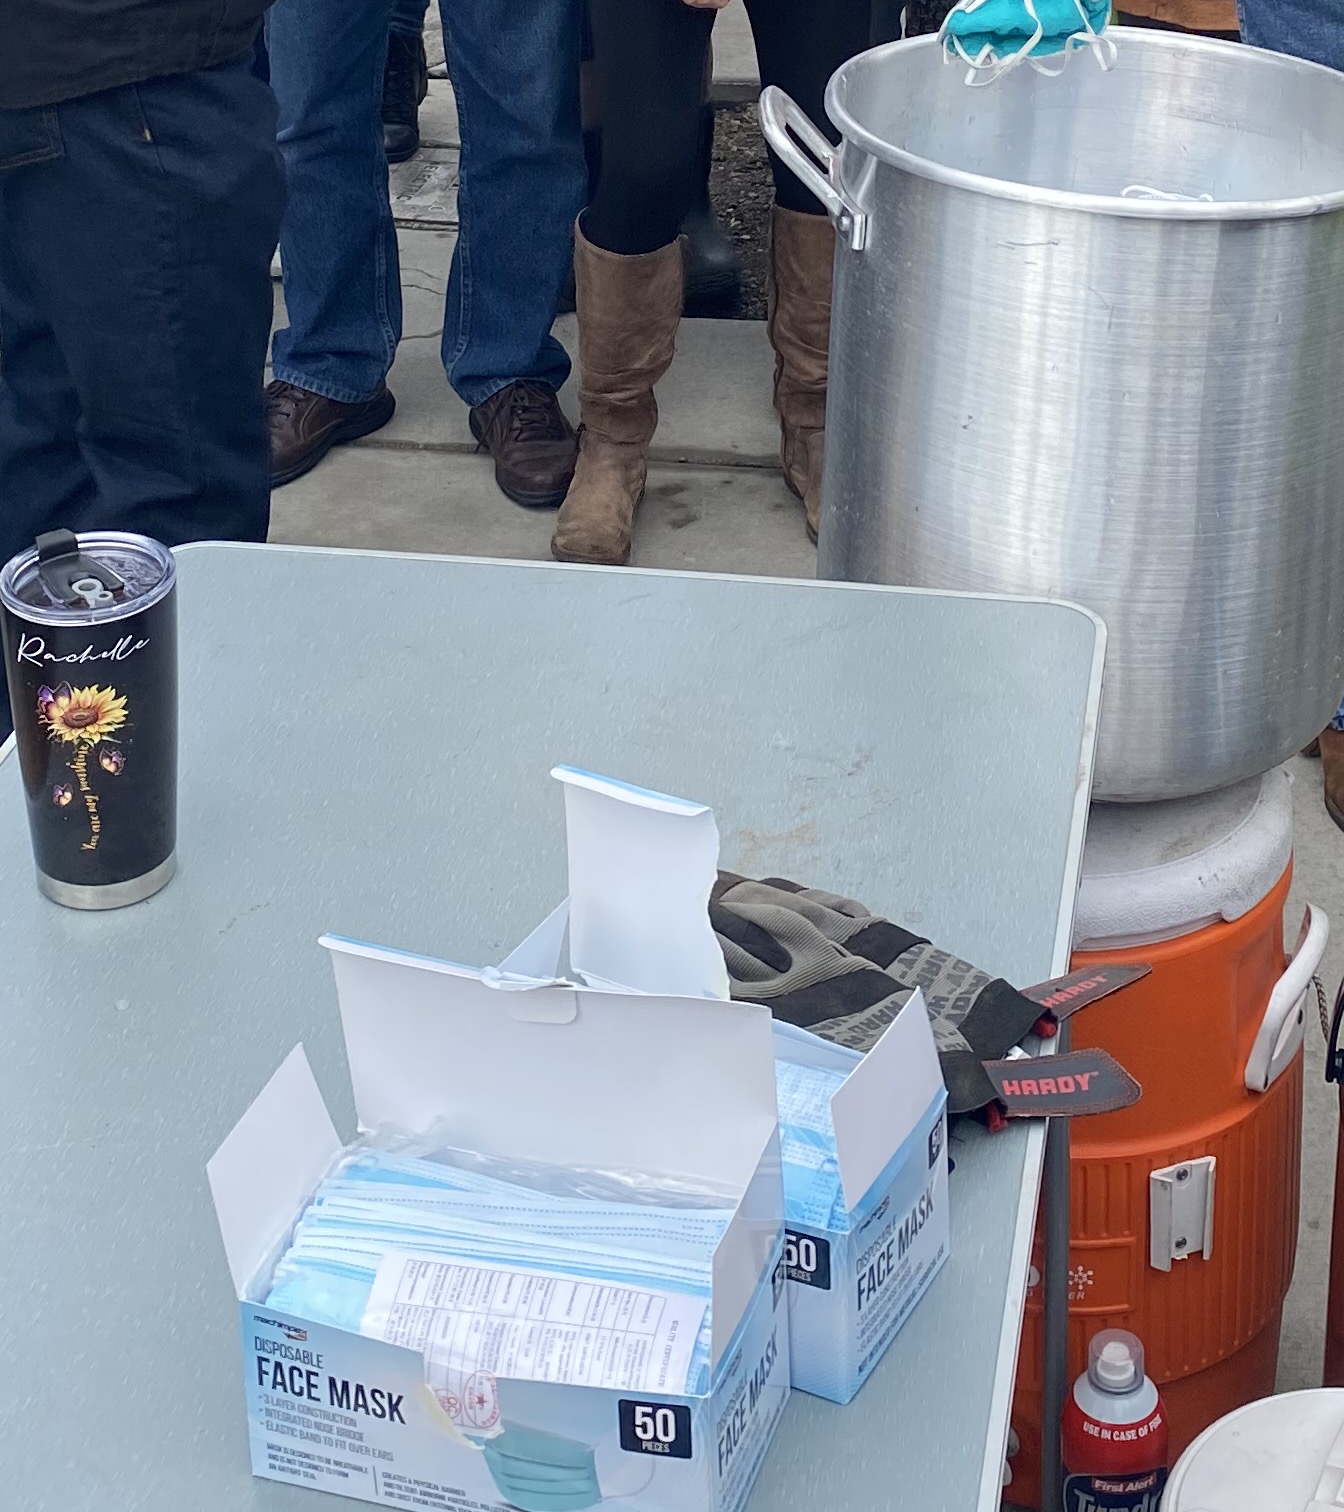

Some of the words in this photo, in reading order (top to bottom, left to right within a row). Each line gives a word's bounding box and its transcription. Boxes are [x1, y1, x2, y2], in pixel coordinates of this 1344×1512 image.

[16, 632, 150, 667] Rachelle
[1039, 974, 1107, 1008] HARDY
[783, 1235, 817, 1272] 50
[857, 1238, 894, 1311] FACE
[898, 1179, 934, 1261] MASK
[254, 1336, 324, 1369] DISPOSABLE
[256, 1355, 321, 1403] FACE
[328, 1375, 407, 1426] MASK
[718, 1394, 747, 1478] FACE
[749, 1323, 778, 1415] MASK
[263, 1394, 270, 1404] 3
[271, 1396, 296, 1411] LAYER
[297, 1402, 357, 1428] CONSTRUCTION
[265, 1407, 312, 1429] INTEGRATED
[314, 1420, 334, 1435] NOSE
[336, 1426, 364, 1442] BRIDGE
[634, 1405, 676, 1443] 50
[266, 1420, 298, 1438] ELASTIC
[299, 1429, 321, 1444] BAND
[323, 1435, 334, 1448] TO
[335, 1439, 347, 1451] FIT
[349, 1442, 371, 1456] OVER
[372, 1448, 394, 1462] EARS
[642, 1441, 670, 1453] PIECES
[1083, 1421, 1099, 1437] USE
[1101, 1428, 1111, 1440] IN
[1113, 1429, 1137, 1441] CASE
[1138, 1424, 1149, 1438] OF
[1095, 1479, 1124, 1492] First
[1125, 1475, 1154, 1491] Alert
